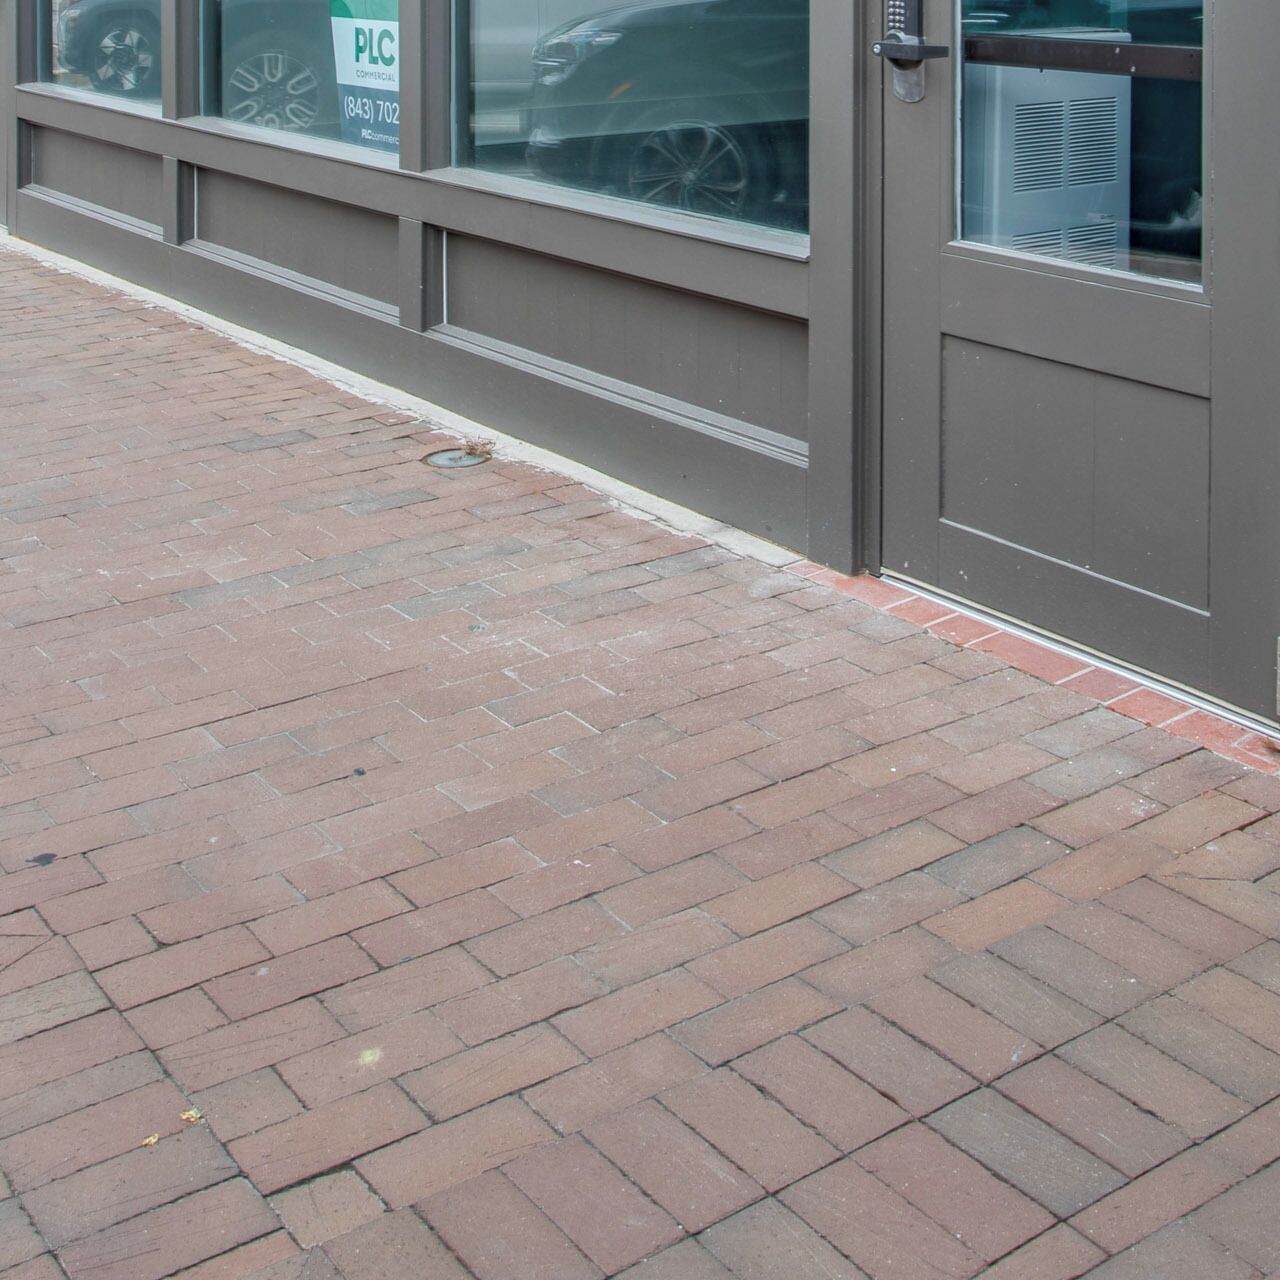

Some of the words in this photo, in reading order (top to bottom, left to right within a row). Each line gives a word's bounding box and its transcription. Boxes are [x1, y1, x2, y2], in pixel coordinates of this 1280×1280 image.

[355, 27, 395, 66] PLC
[356, 70, 395, 81] COMMERCIAL
[344, 95, 374, 124] (843)
